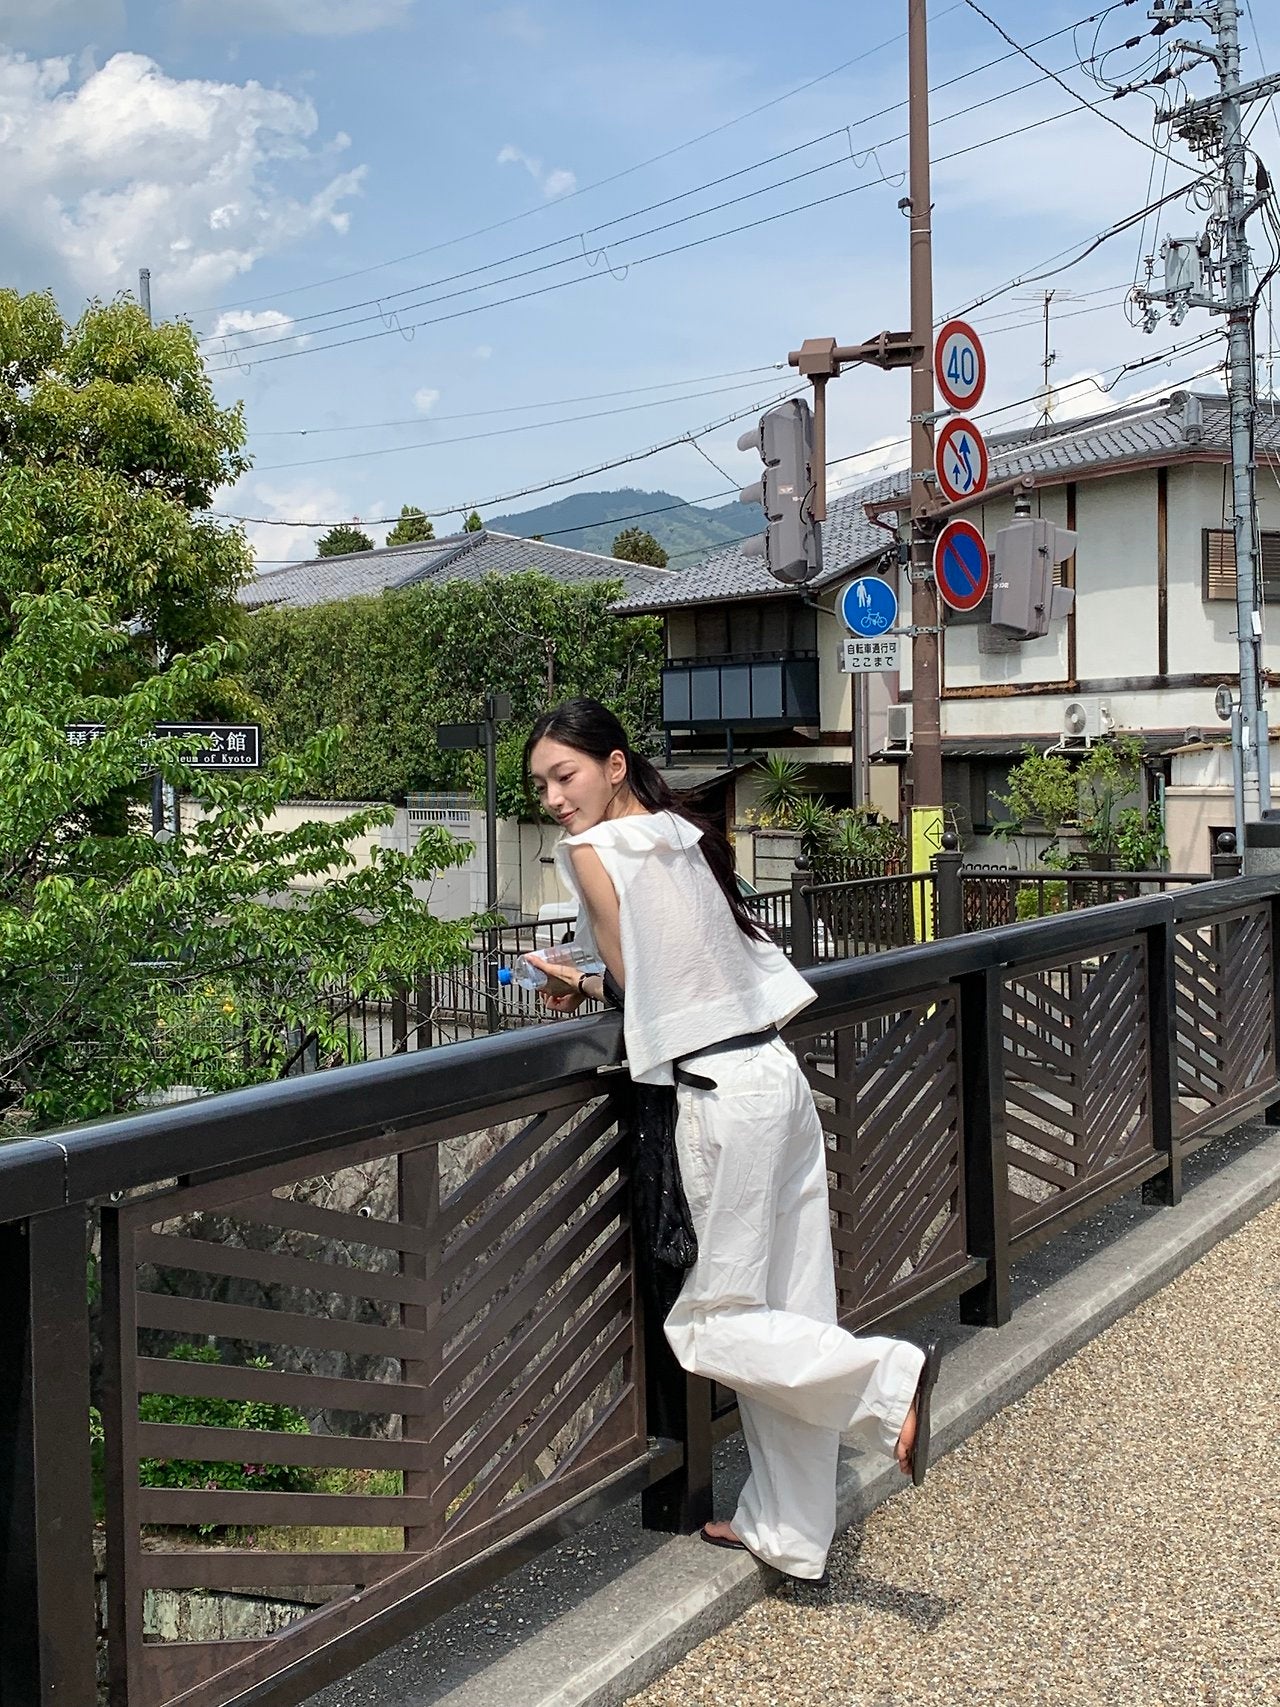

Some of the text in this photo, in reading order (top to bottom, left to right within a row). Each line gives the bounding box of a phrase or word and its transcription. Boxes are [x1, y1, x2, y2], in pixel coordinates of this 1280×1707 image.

[947, 345, 975, 385] 40
[847, 642, 897, 655] 自転車通行可
[852, 656, 894, 668] ここまで
[203, 753, 217, 763] of
[221, 753, 252, 764] Kyoto
